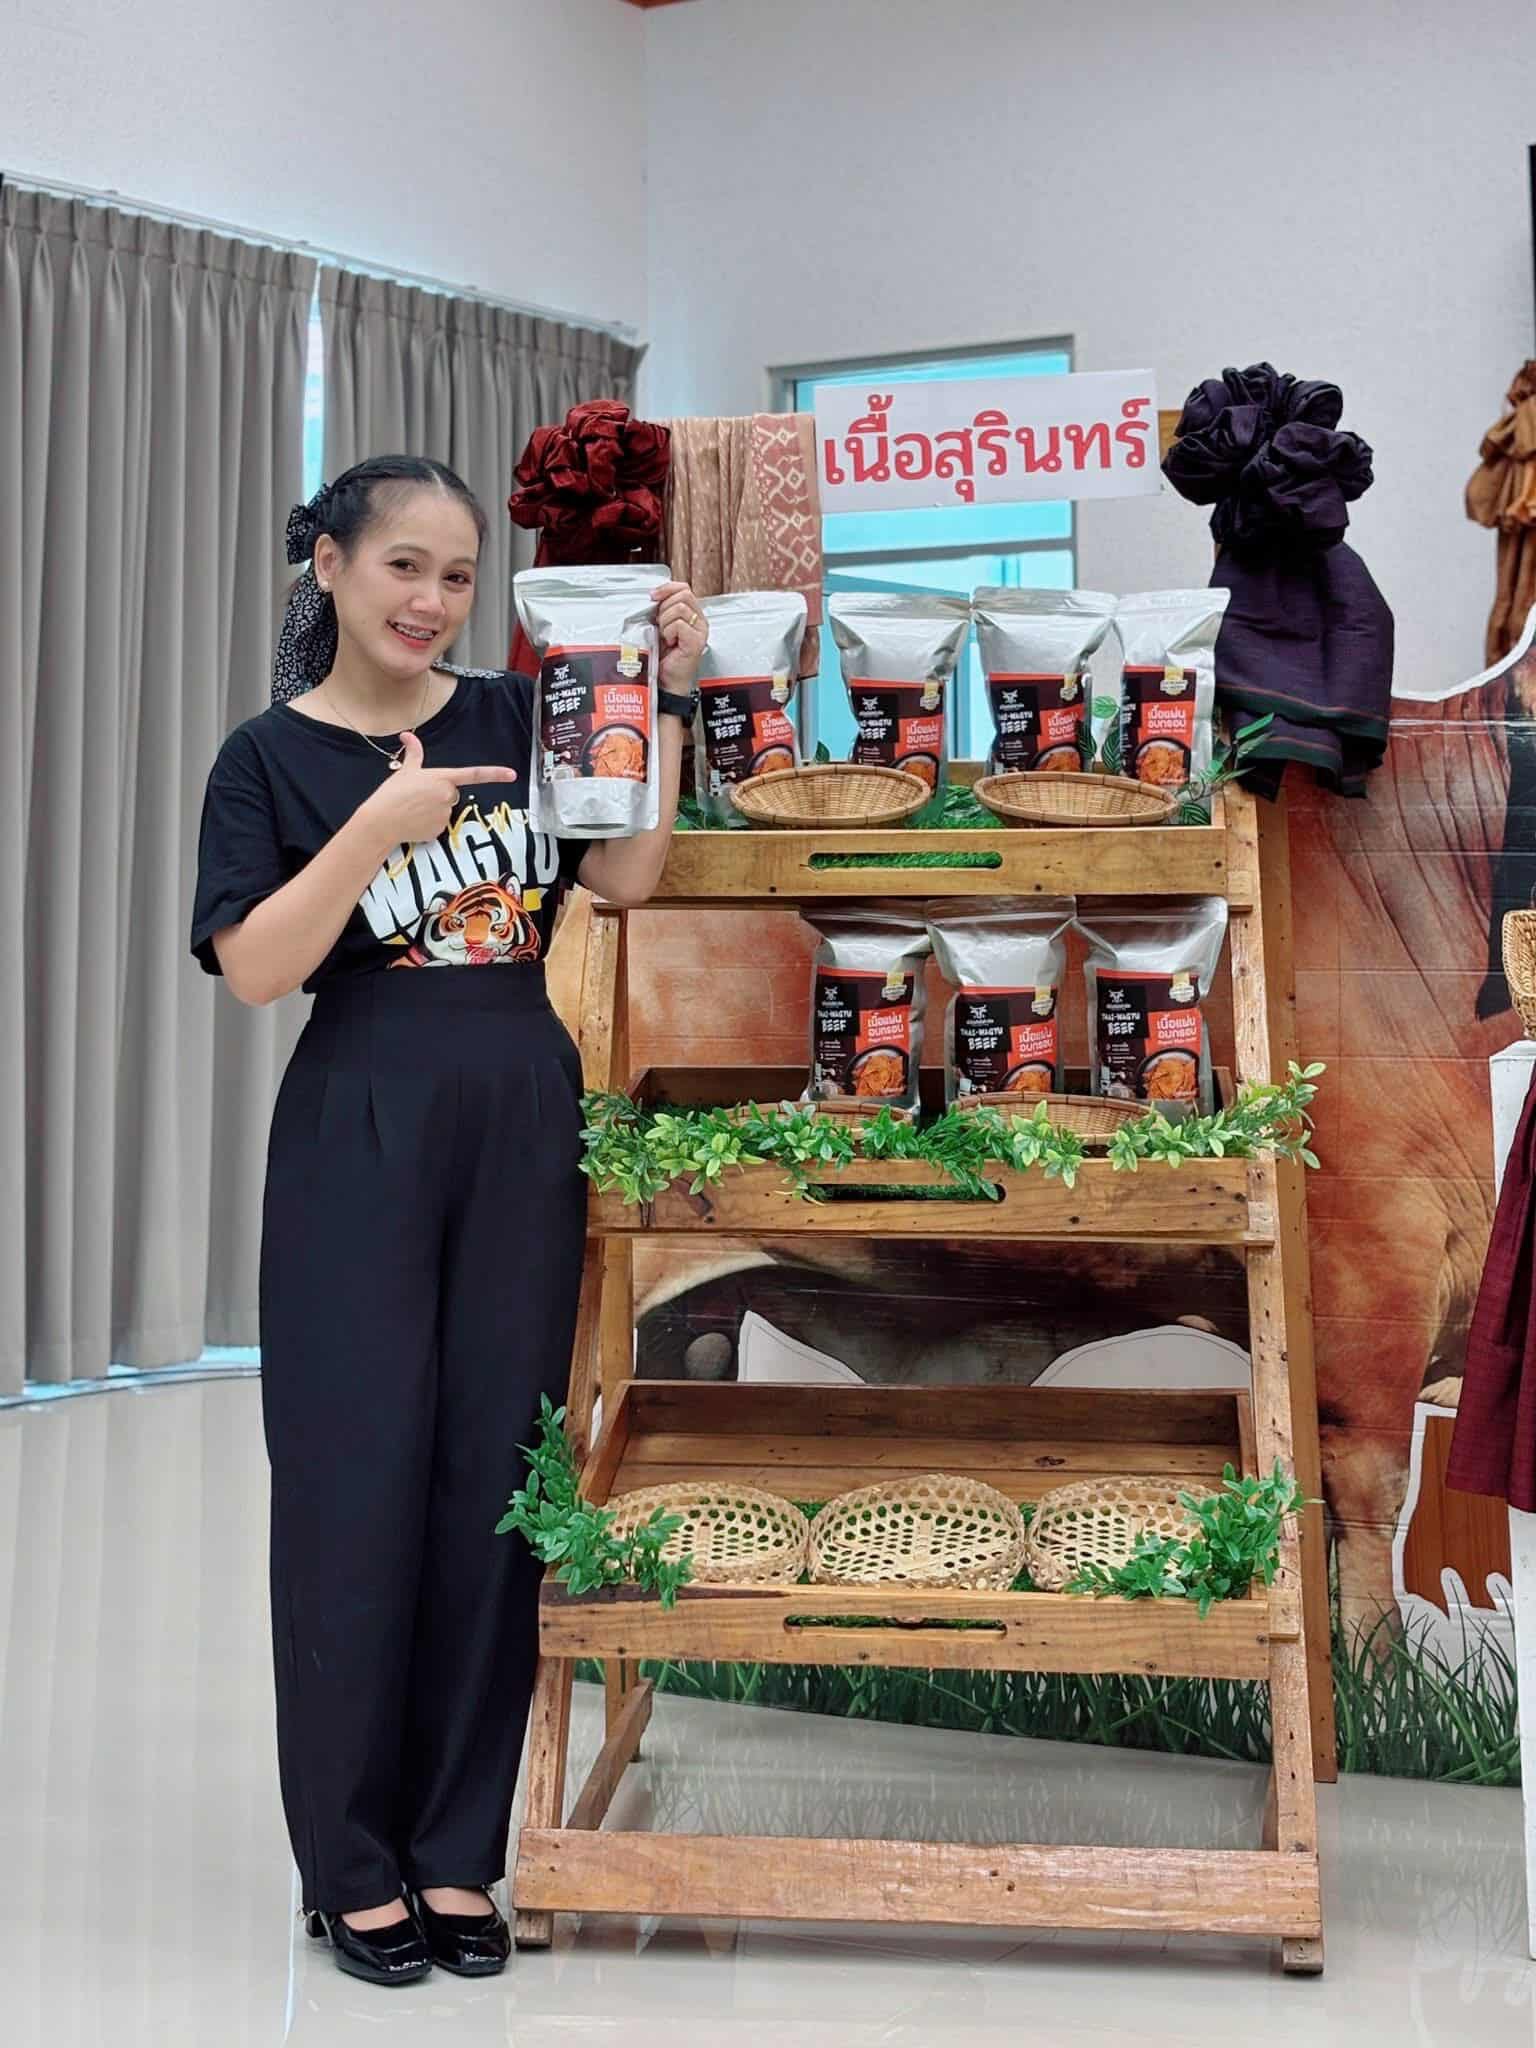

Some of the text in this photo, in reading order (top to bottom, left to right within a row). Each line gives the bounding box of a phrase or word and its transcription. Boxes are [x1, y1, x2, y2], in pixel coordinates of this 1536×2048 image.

[824, 394, 1151, 502] เนื้อสุรินทร์
[551, 697, 582, 716] BEEF
[359, 808, 560, 941] WAGYU
[967, 1037, 998, 1050] BEEF
